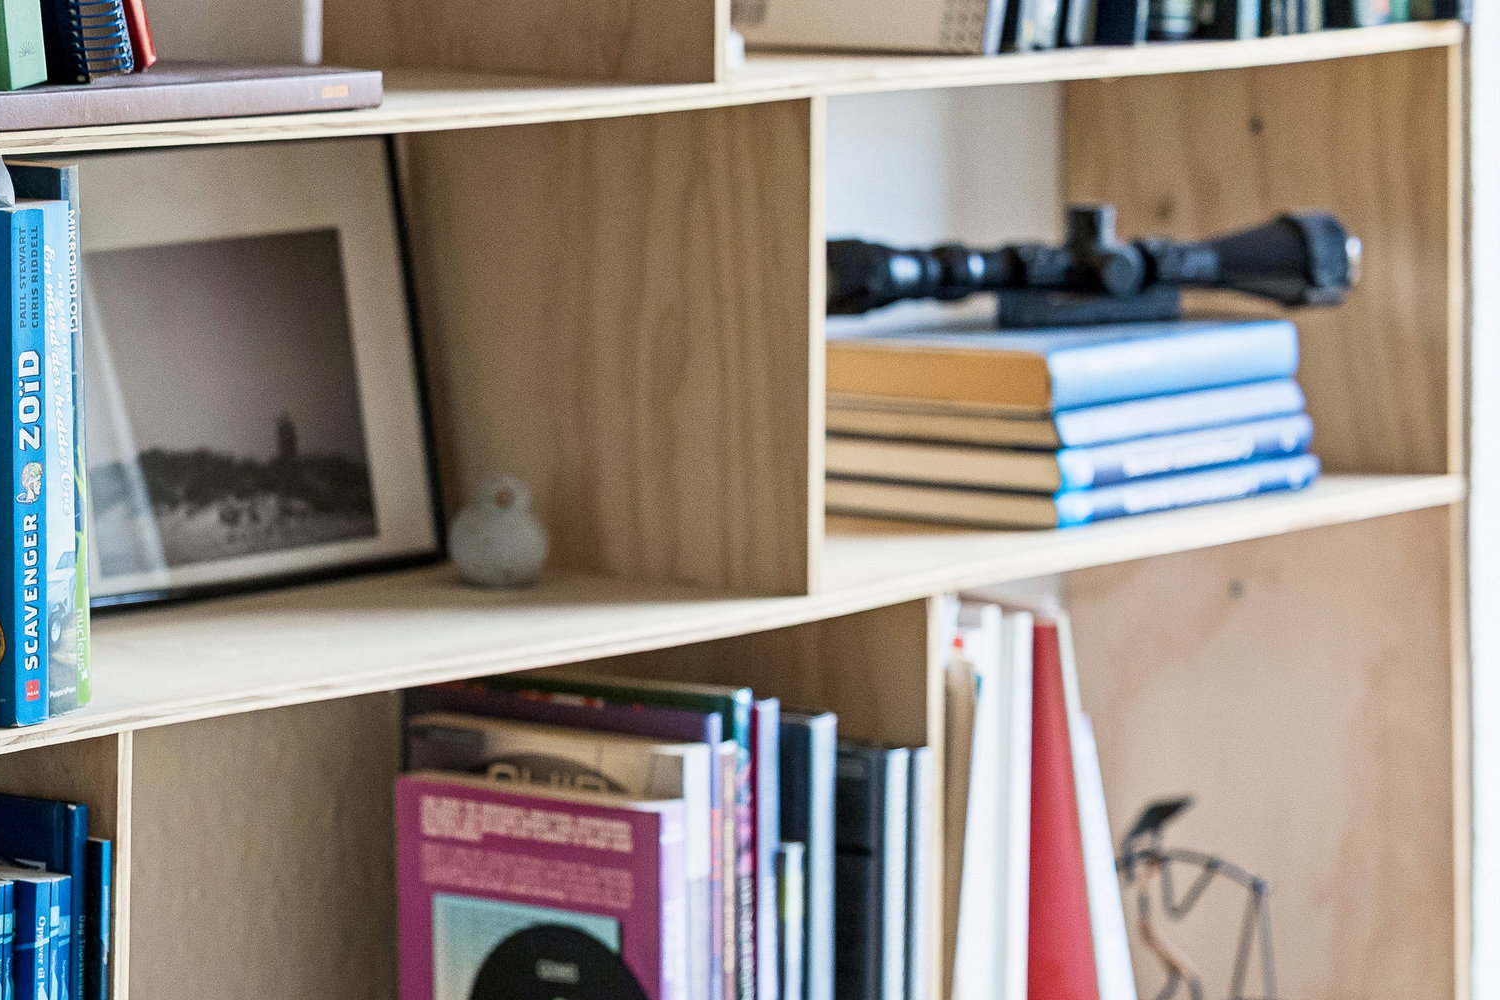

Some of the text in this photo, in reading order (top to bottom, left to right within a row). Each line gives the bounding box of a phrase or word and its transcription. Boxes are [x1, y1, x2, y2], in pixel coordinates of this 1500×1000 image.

[19, 227, 27, 329] PAUL STEWART
[31, 225, 39, 329] CHRIS RIDDELL
[67, 209, 79, 333] MIKROBIOLOGI
[45, 282, 62, 347] mand
[50, 350, 66, 388] der
[53, 393, 71, 469] hedder
[59, 473, 74, 516] Ove
[24, 513, 40, 671] SCAVENGER
[37, 967, 45, 979] til
